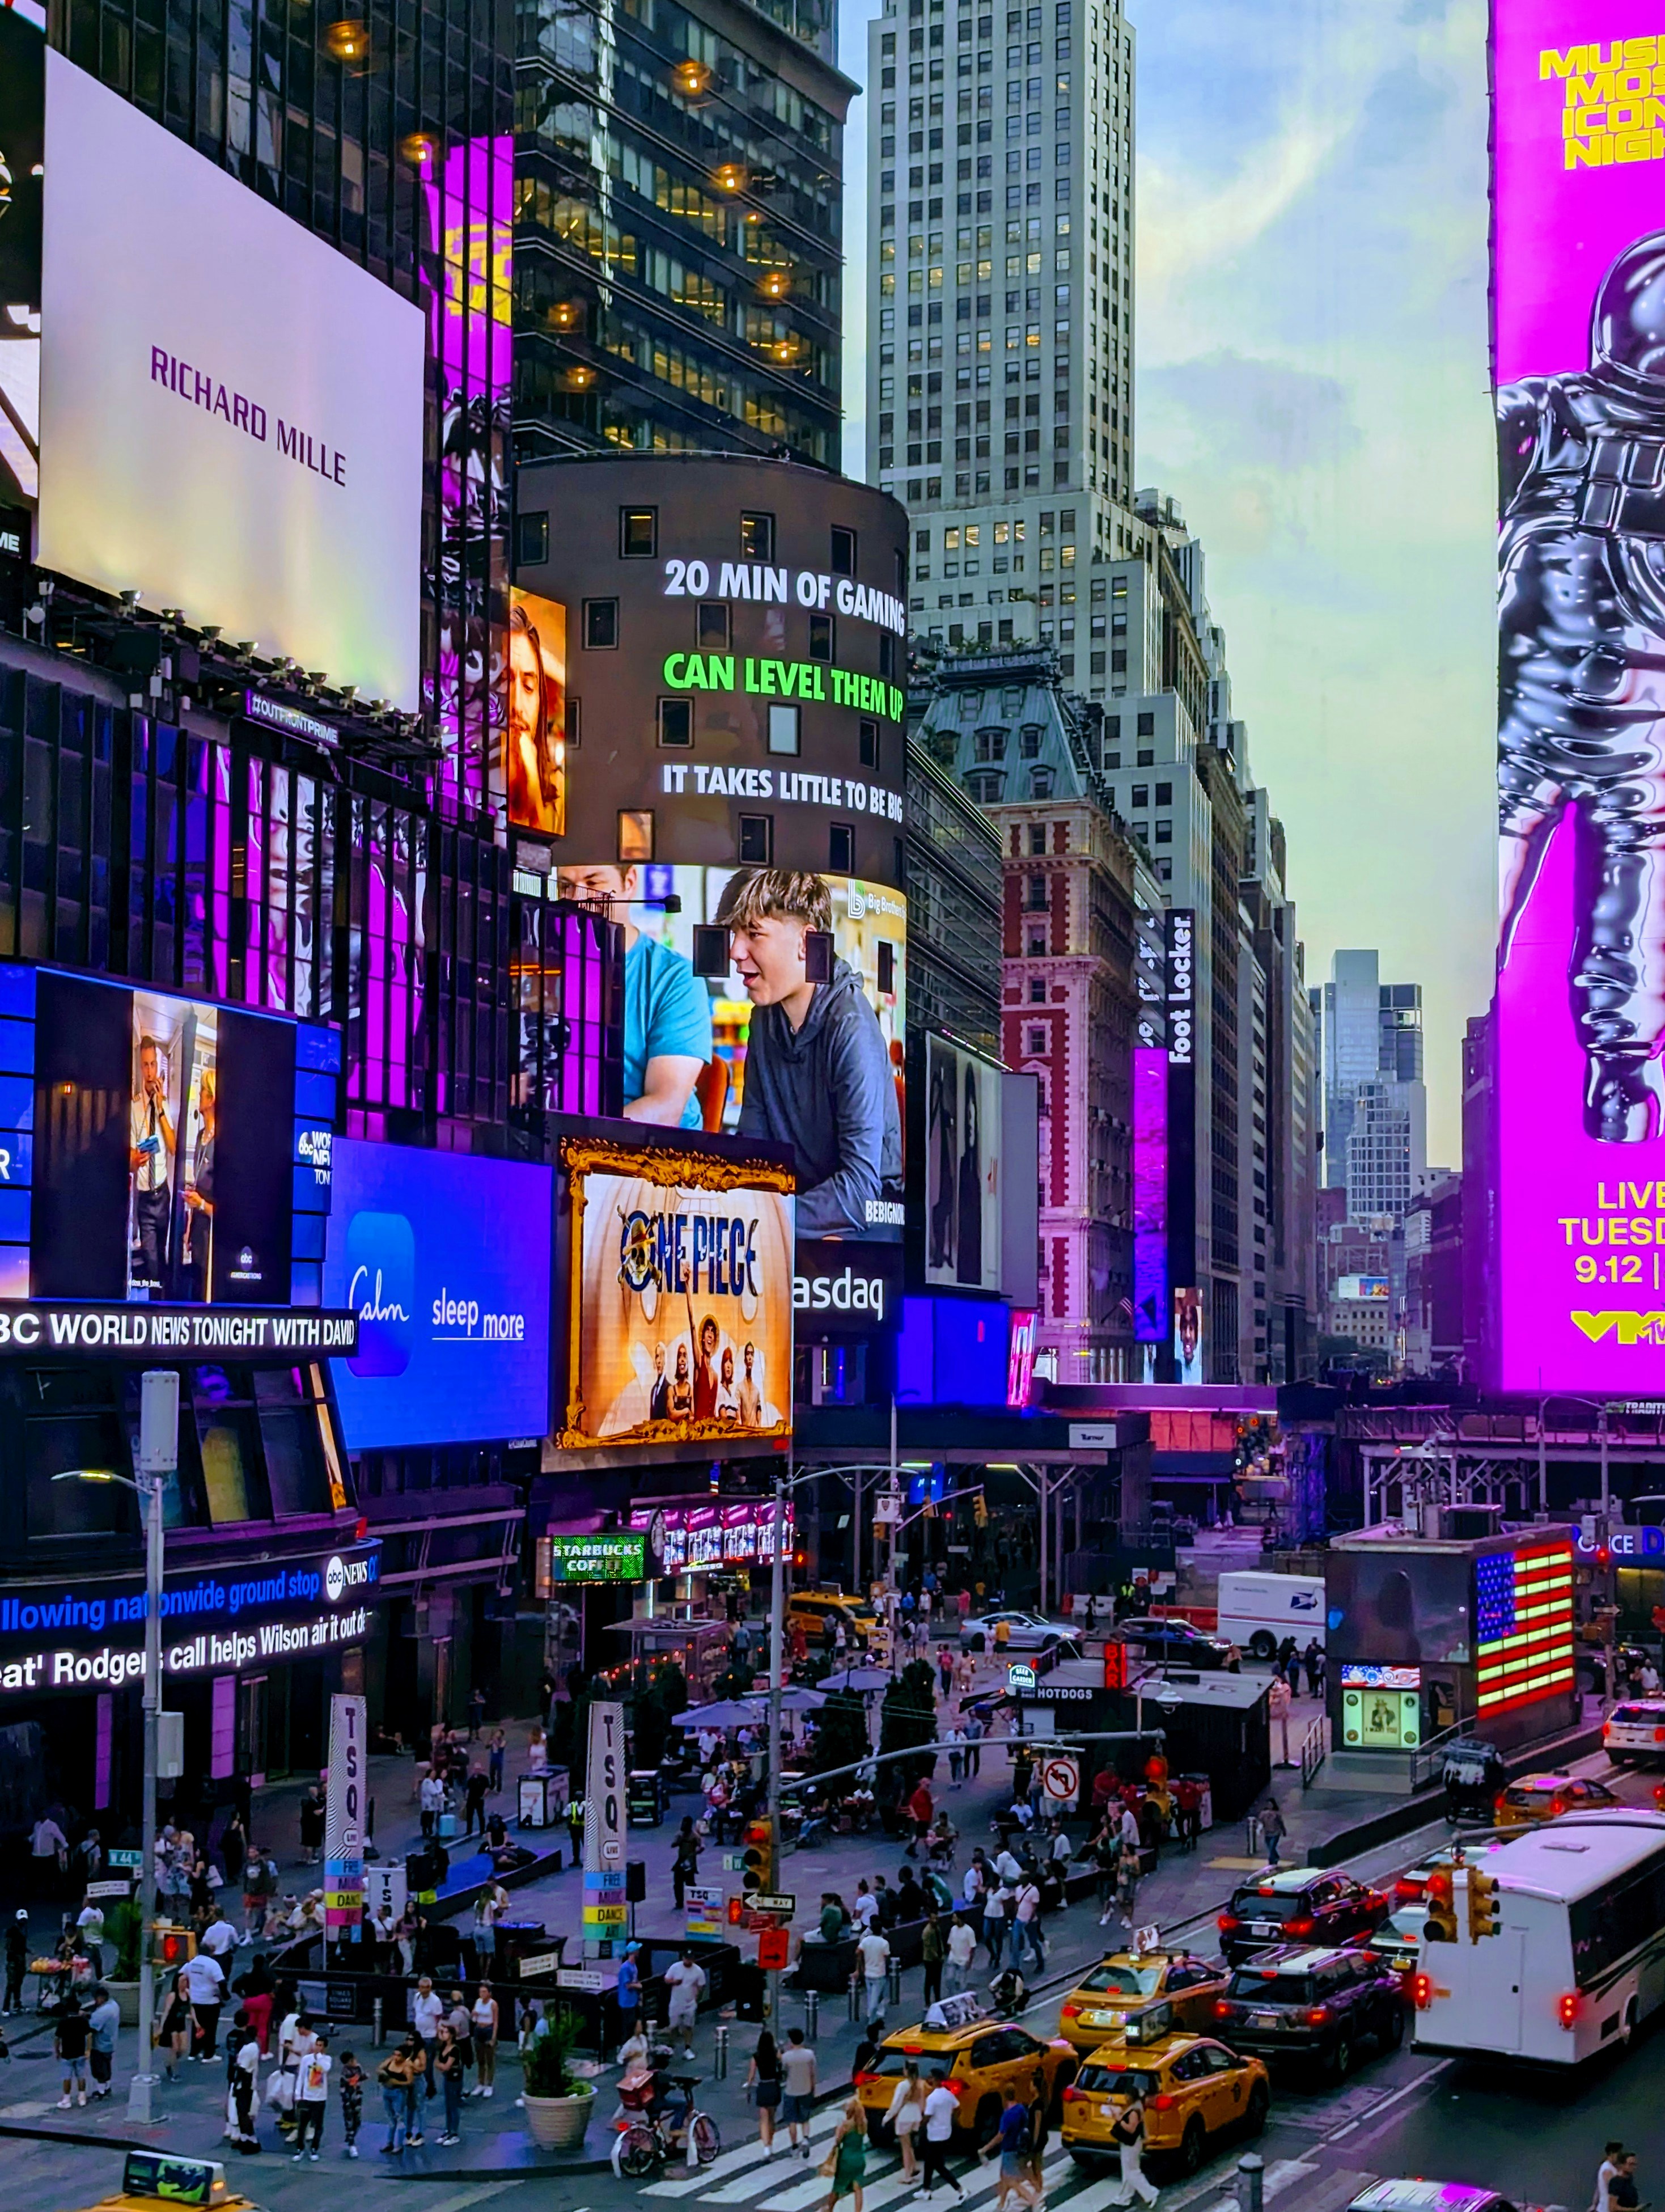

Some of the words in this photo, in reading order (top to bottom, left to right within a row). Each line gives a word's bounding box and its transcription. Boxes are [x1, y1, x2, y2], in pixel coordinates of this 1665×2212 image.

[151, 345, 266, 442] RICHARD
[277, 418, 346, 487] MILLE
[664, 559, 709, 596] 20
[719, 562, 787, 603] MIN
[797, 571, 831, 609] OF
[837, 579, 905, 637] GAMING
[664, 653, 735, 691] CAN
[745, 658, 825, 701] LEVEL
[831, 669, 886, 716] THEM
[889, 685, 903, 723] UP
[663, 765, 688, 793] IT
[693, 765, 773, 797] TAKES
[780, 772, 842, 806] LITTLE
[845, 781, 866, 811] TO
[870, 786, 886, 817] BE
[888, 792, 903, 823] BIG
[868, 893, 881, 915] Big
[1168, 1009, 1191, 1058] Foot
[620, 1210, 688, 1294] ONE
[693, 1215, 760, 1297] PIECE
[1575, 1255, 1643, 1284] 9.12
[349, 1265, 410, 1322] Calm
[432, 1287, 479, 1336] sleep
[484, 1313, 524, 1338] more
[794, 1267, 883, 1321] asdaq
[50, 1314, 147, 1345] WORLD
[151, 1316, 189, 1346] NEWS
[193, 1317, 269, 1346] TONIGHT
[272, 1318, 320, 1346] WITH
[323, 1319, 355, 1346] DAVID
[553, 1543, 642, 1557] STARBUCKS
[230, 1570, 285, 1613] ground
[289, 1570, 320, 1600] stop
[342, 1561, 367, 1586] NEWS
[170, 1636, 205, 1670] call
[210, 1631, 256, 1667] helps
[259, 1623, 308, 1655] Wilson
[312, 1616, 329, 1646] air
[331, 1614, 337, 1642] it
[340, 1610, 355, 1638] out
[1012, 1675, 1032, 1684] GARDEN
[1105, 1644, 1119, 1689] BAR
[1037, 1688, 1093, 1700] HOTDOGS
[345, 1707, 358, 1821] TSQ
[604, 1715, 618, 1833] TSQ
[603, 1873, 620, 1887] FREE
[690, 1890, 708, 1900] TSQ
[598, 1908, 622, 1922] DANCE
